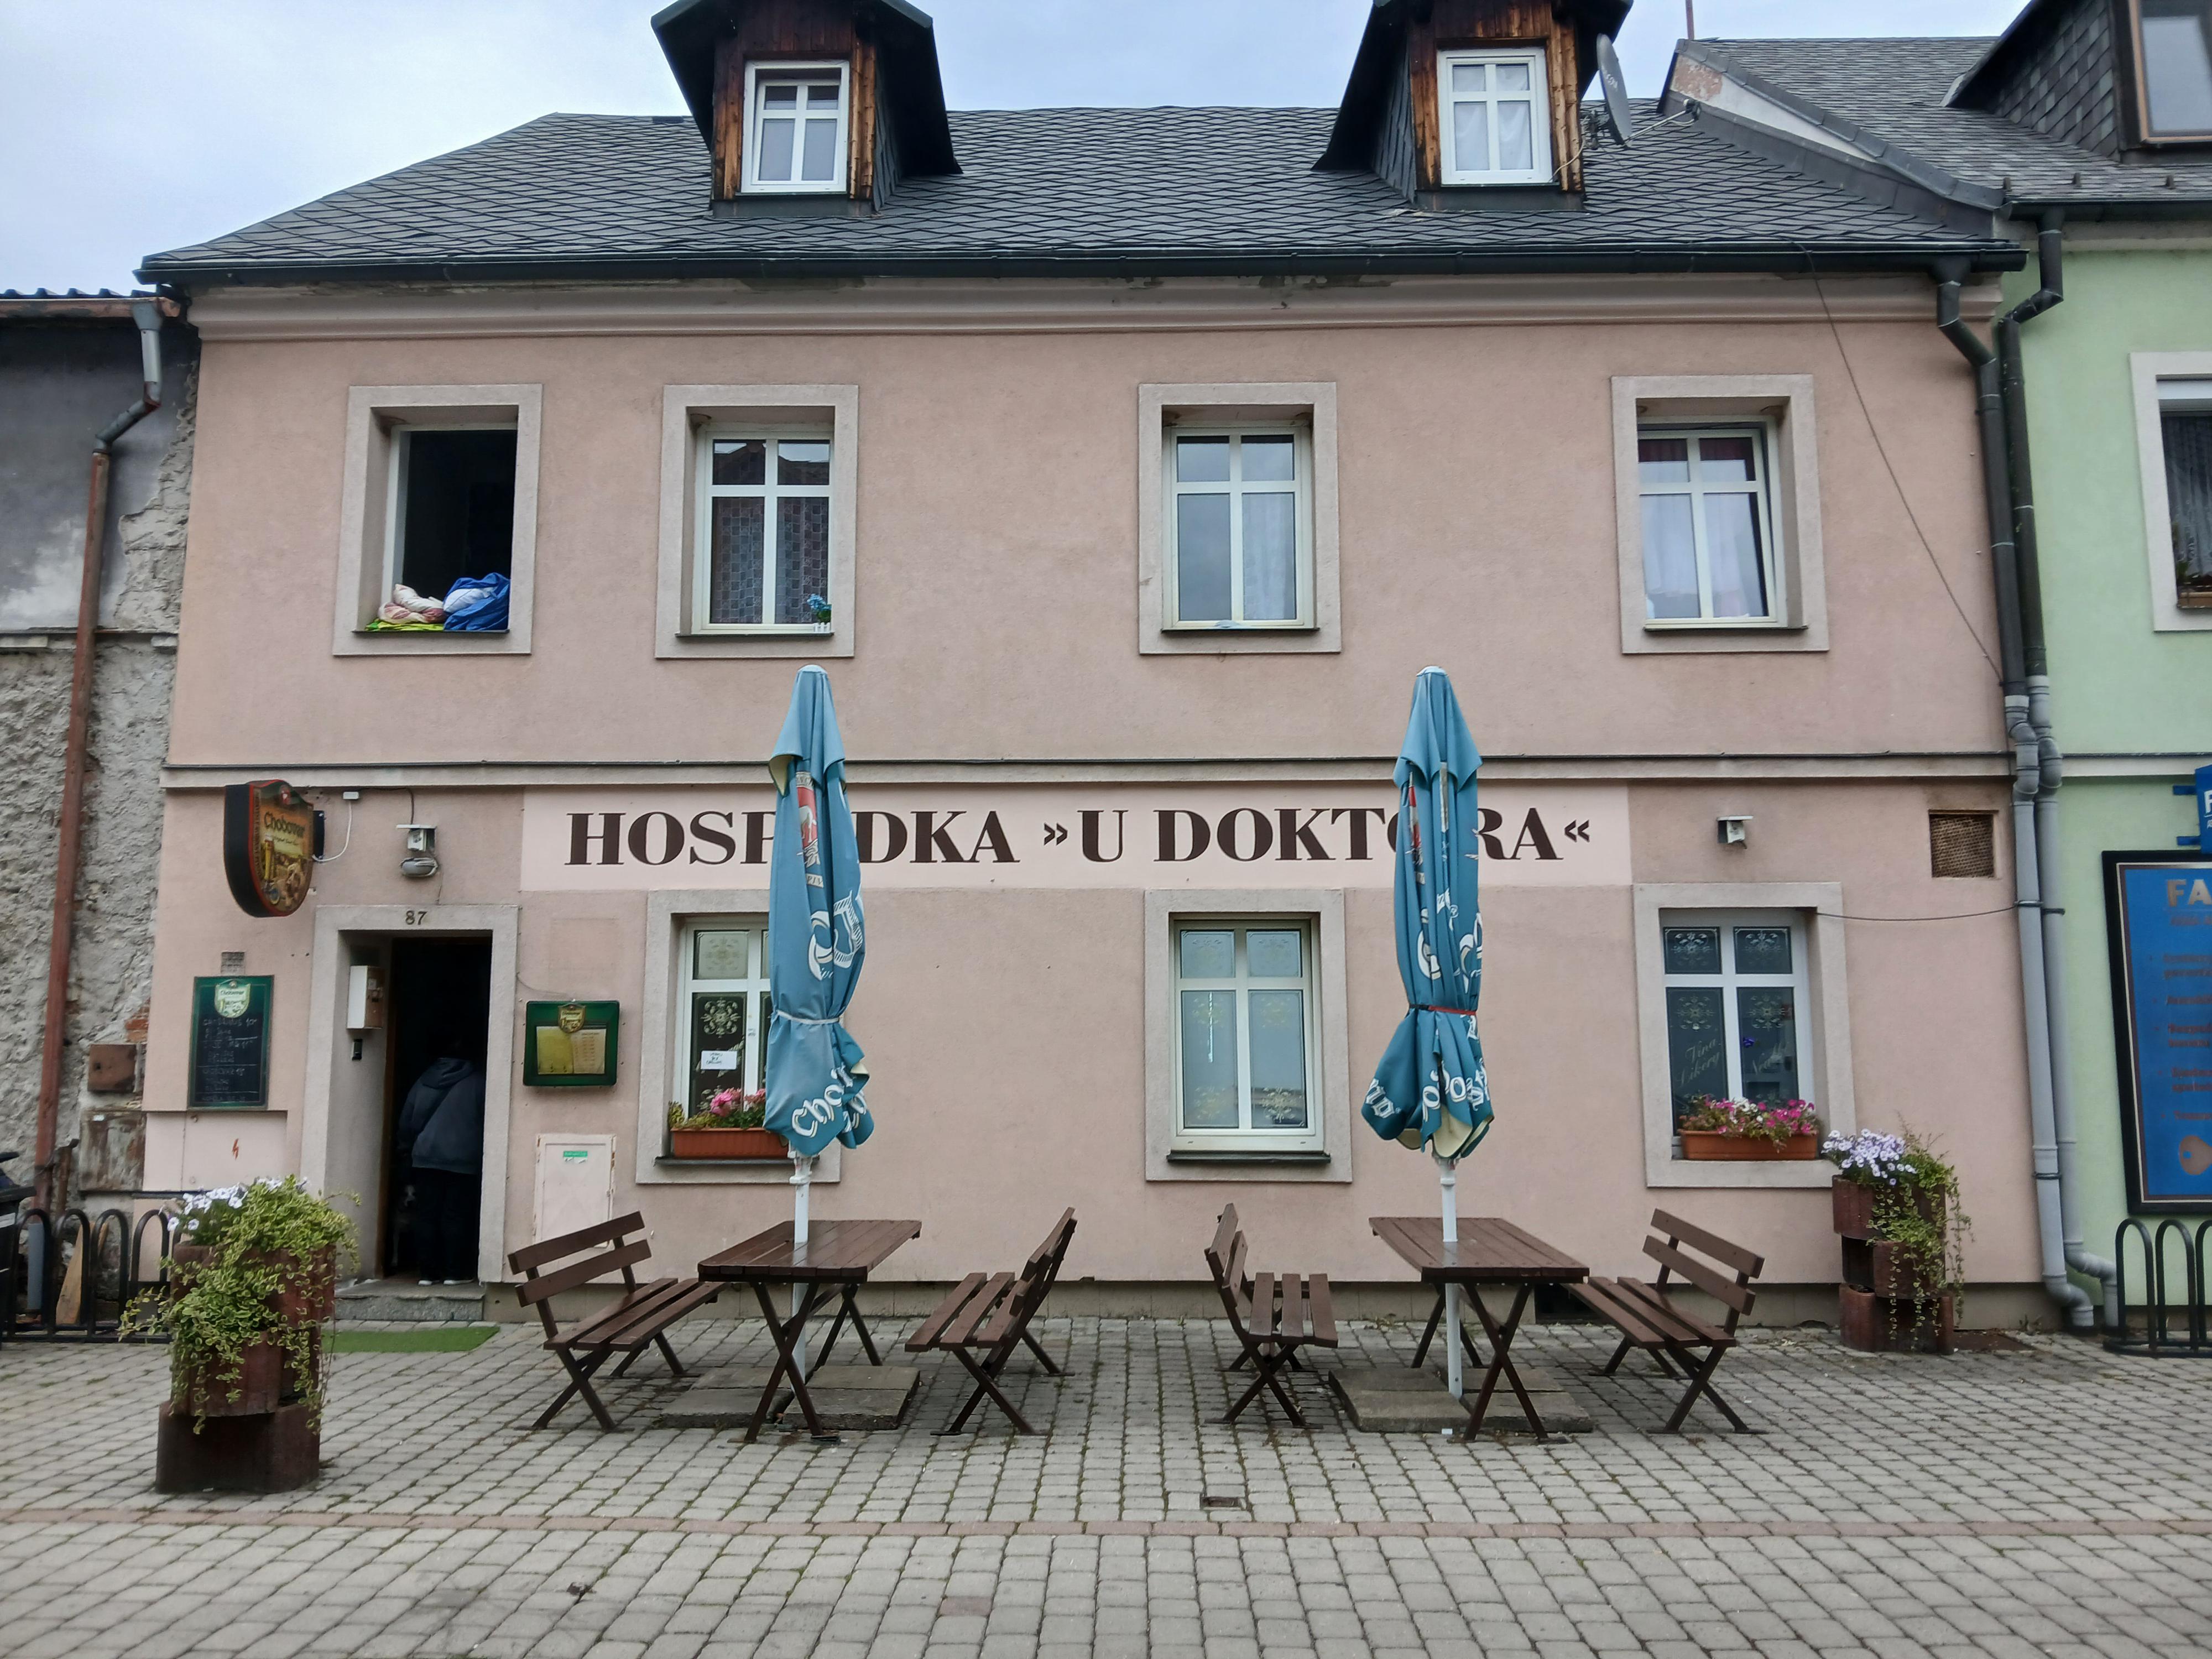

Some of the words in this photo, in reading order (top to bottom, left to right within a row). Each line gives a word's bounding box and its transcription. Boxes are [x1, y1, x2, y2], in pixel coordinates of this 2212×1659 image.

[565, 811, 1020, 865] HOSPDKA
[1153, 808, 1589, 862] DOKTRA«
[405, 910, 428, 925] 87
